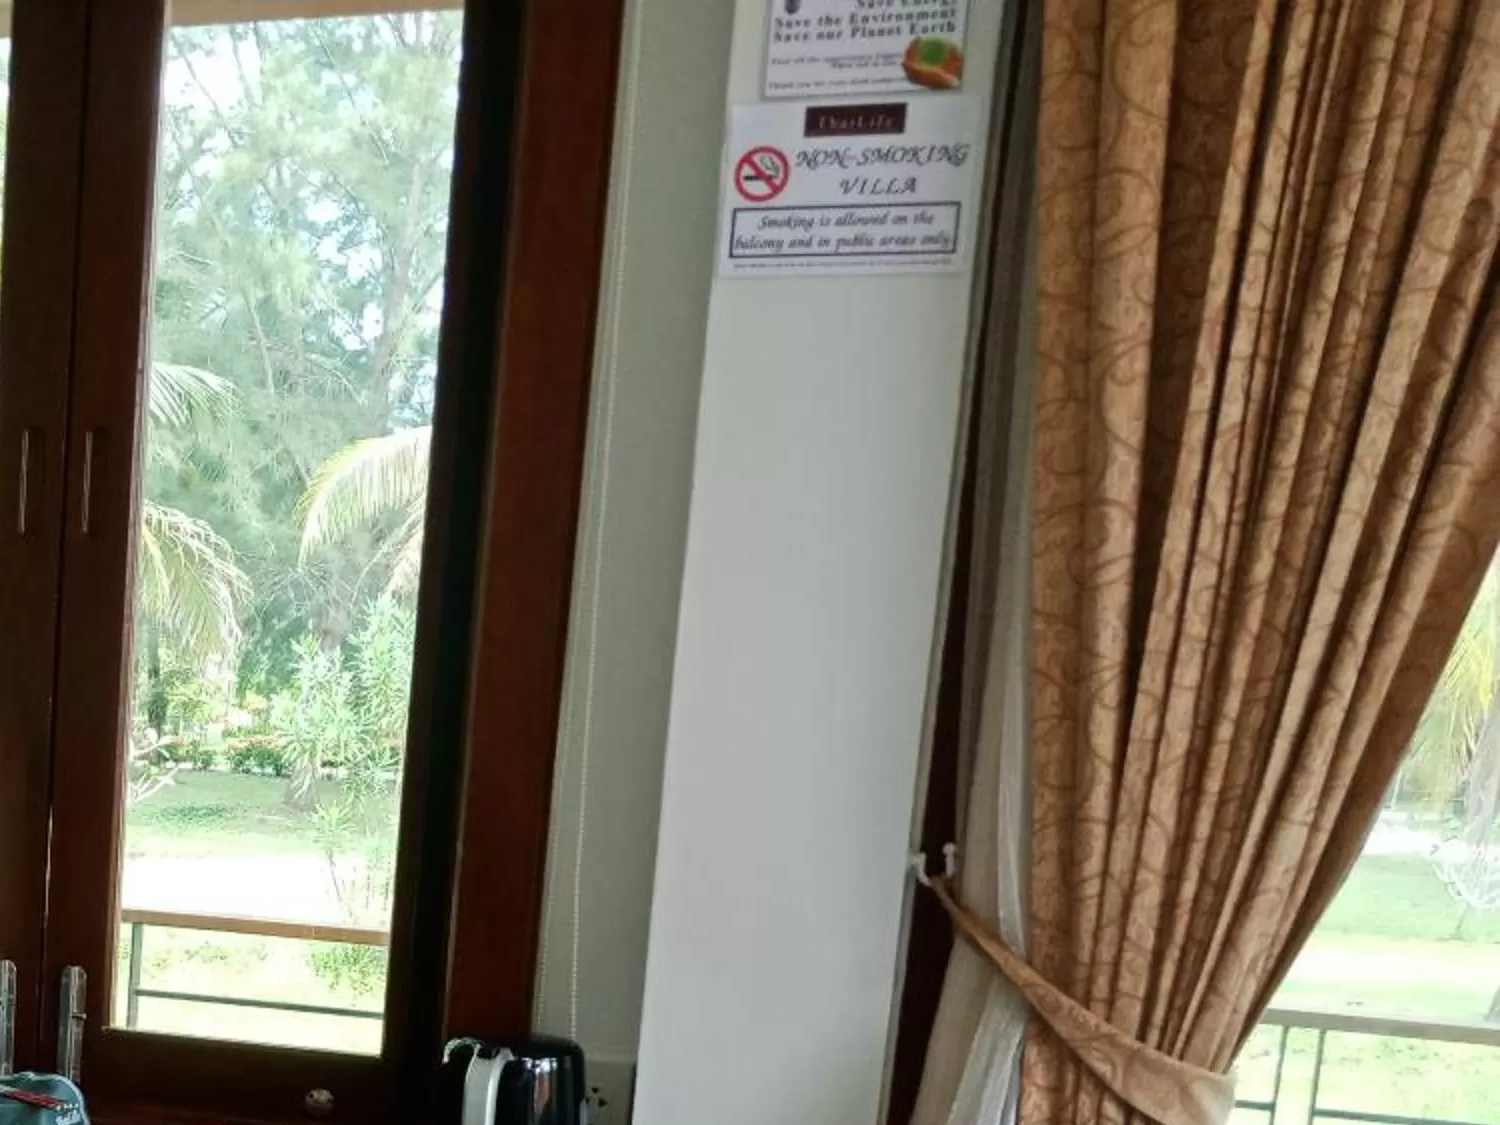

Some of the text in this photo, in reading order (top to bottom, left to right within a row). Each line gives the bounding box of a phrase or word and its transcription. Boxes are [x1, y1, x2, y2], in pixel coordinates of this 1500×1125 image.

[775, 9, 957, 28] Save the Environment
[773, 30, 810, 42] Save
[851, 25, 901, 38] Planet
[909, 21, 956, 36] Earth
[795, 143, 971, 171] NON-SMOKING
[839, 176, 918, 196] VILLA
[758, 209, 934, 231] Smoking is allowed on the
[734, 236, 785, 252] balcony
[788, 236, 813, 249] and
[817, 237, 831, 249] in
[835, 233, 876, 251] public
[879, 236, 917, 247] areas
